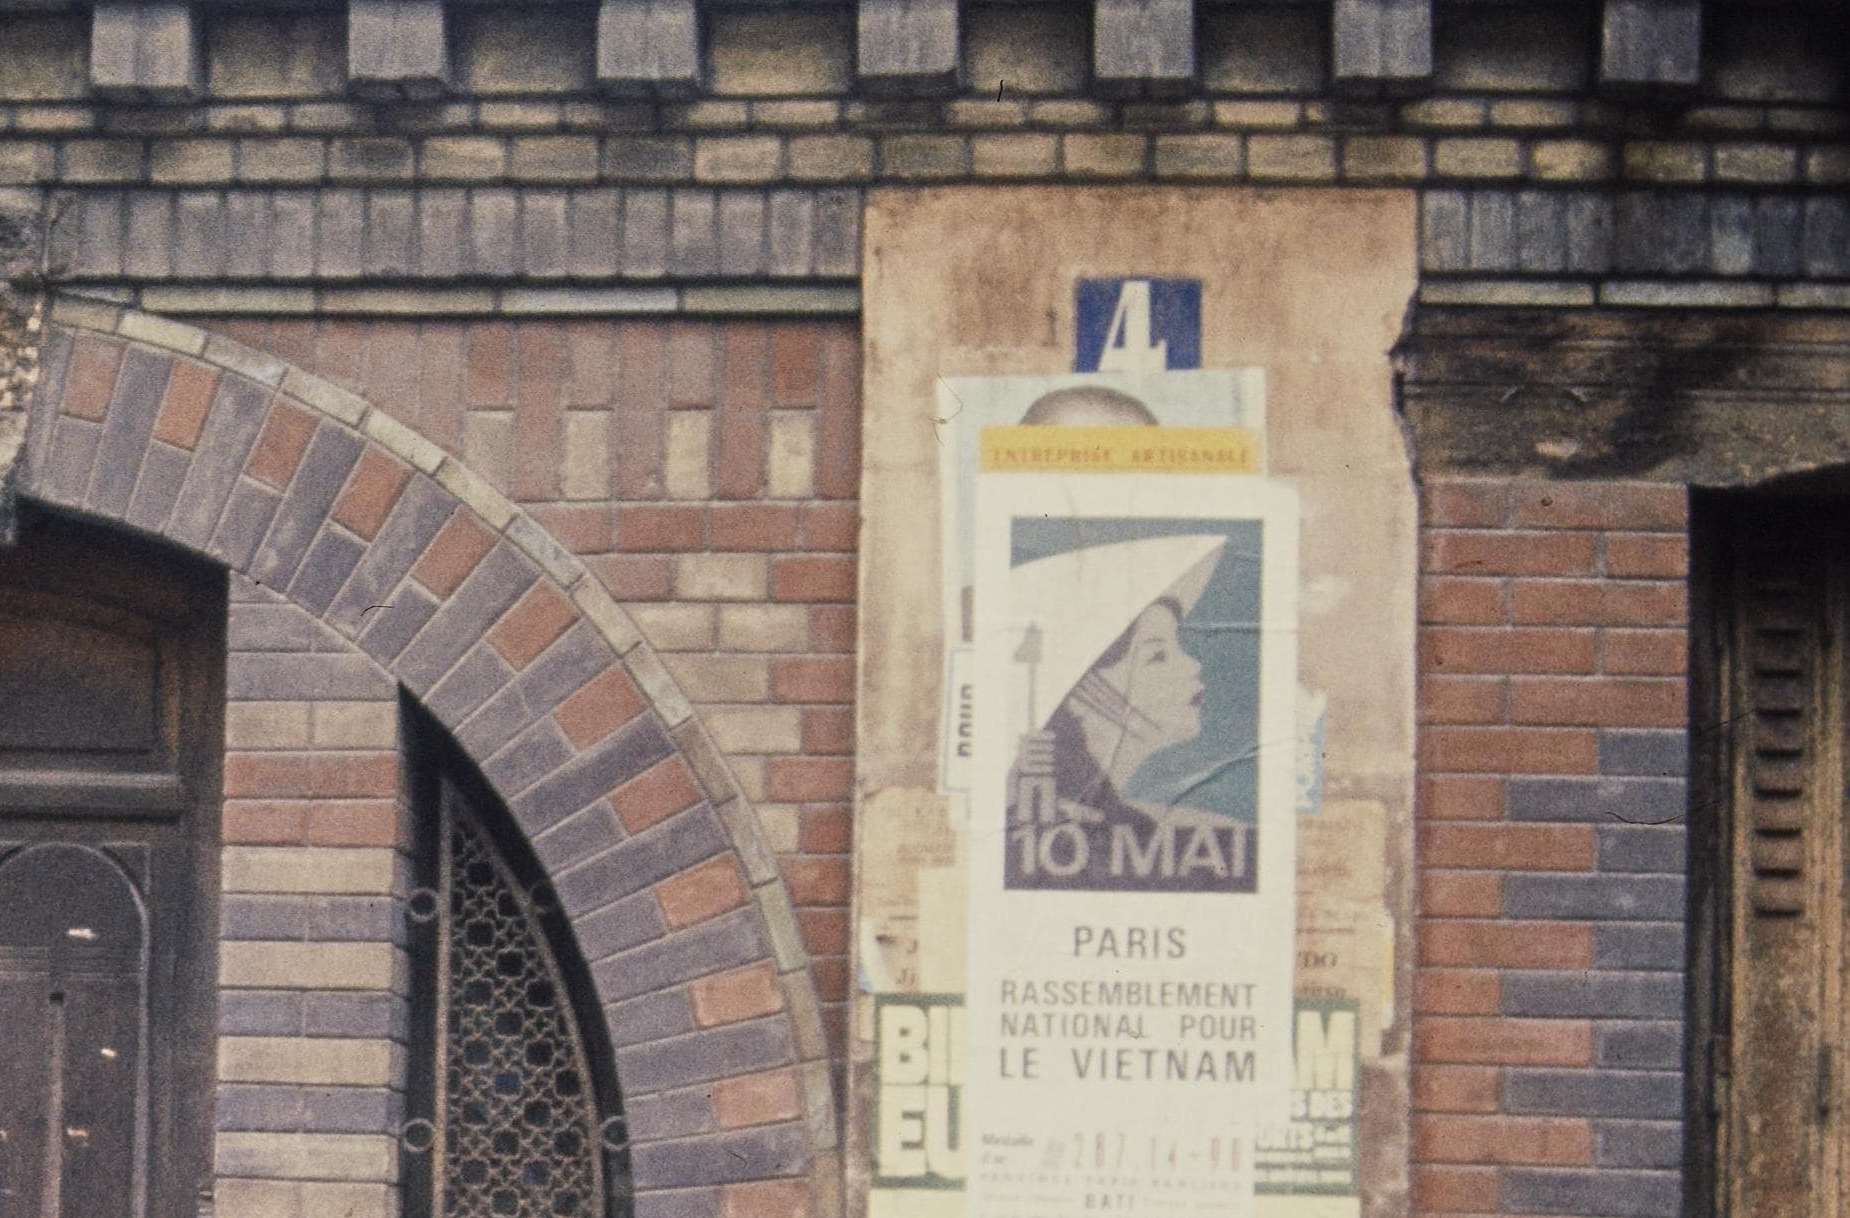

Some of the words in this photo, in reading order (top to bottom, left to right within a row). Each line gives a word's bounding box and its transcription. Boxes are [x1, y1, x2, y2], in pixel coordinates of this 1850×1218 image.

[1011, 821, 1091, 877] 10
[1109, 823, 1248, 879] MAI
[1073, 925, 1187, 959] PARIS
[1000, 979, 1258, 1009] RASSEMBLEMENT
[999, 1011, 1148, 1040] NATIONAL
[1178, 1013, 1257, 1041] POUR
[998, 1047, 1040, 1080] LE
[1071, 1048, 1257, 1083] VIETNAM
